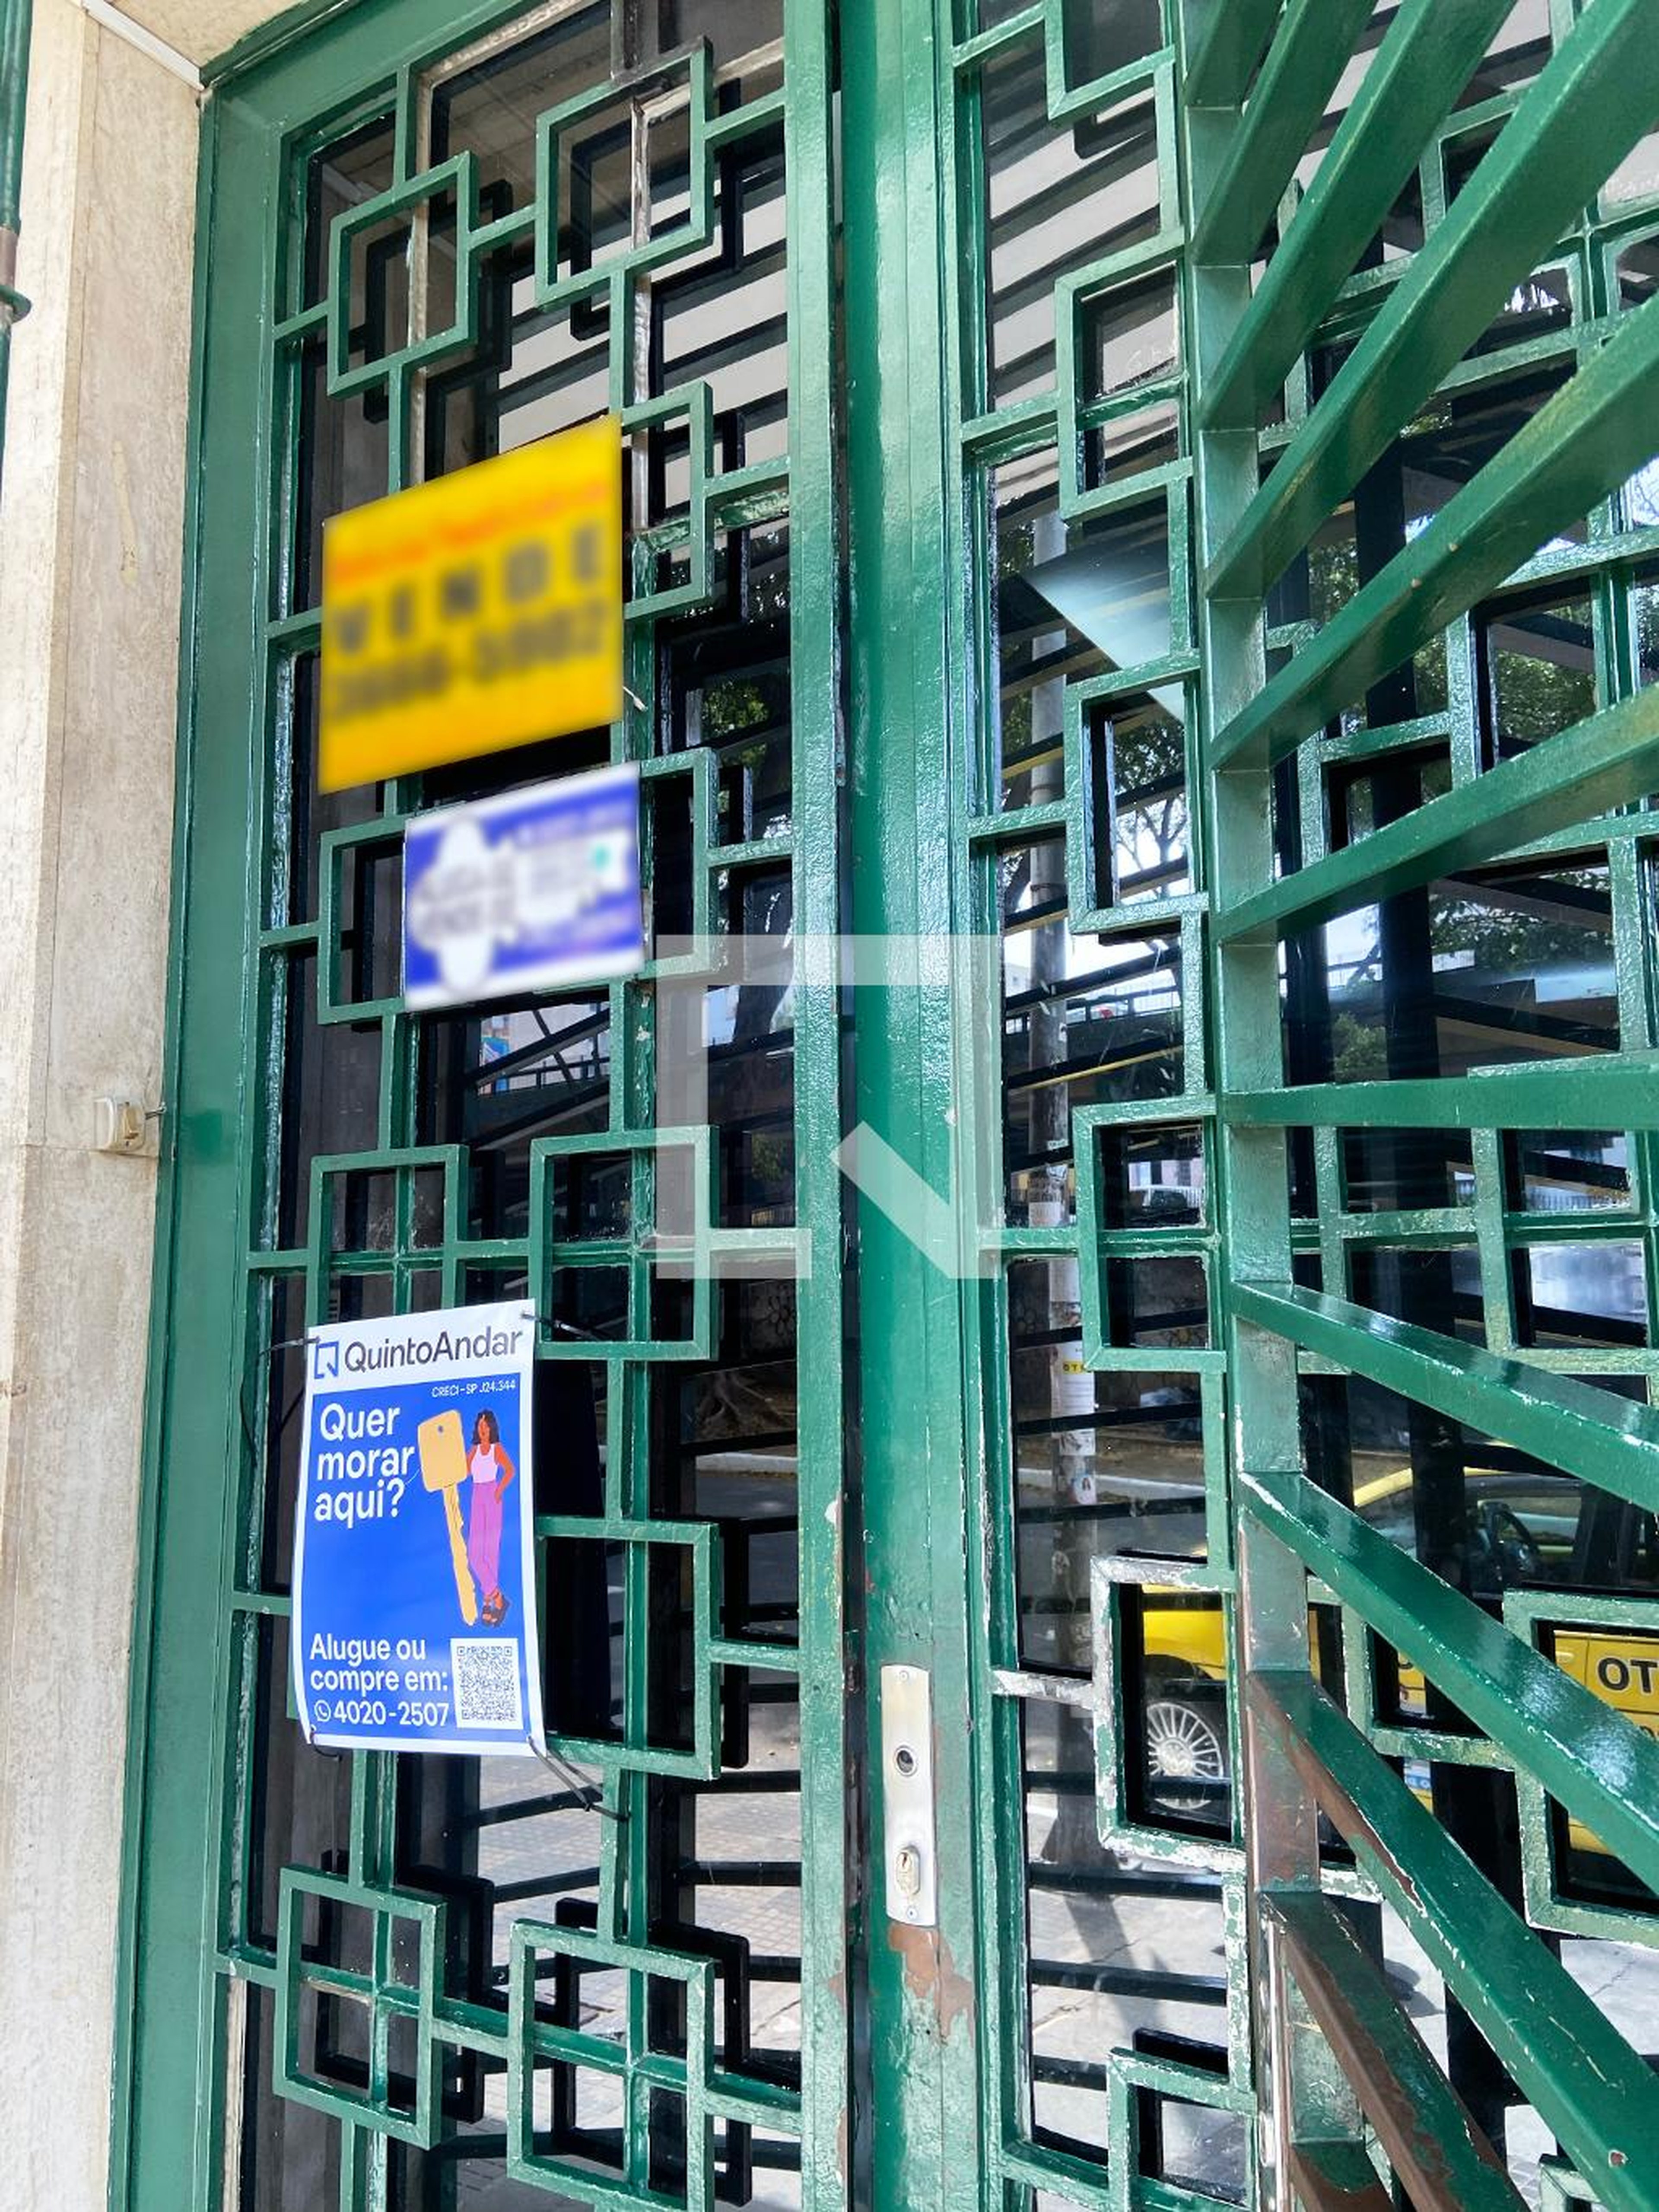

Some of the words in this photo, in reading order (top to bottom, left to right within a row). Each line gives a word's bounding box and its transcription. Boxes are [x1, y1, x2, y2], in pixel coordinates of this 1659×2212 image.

[345, 1326, 523, 1373] QuintoAndar
[320, 1403, 400, 1442] Quer
[317, 1445, 415, 1480] morar
[314, 1479, 404, 1529] aqui?
[309, 1633, 391, 1667] Alugue
[397, 1639, 426, 1660] ou
[310, 1669, 399, 1696] compre
[404, 1671, 448, 1691] em:
[334, 1701, 449, 1727] 4020-2507
